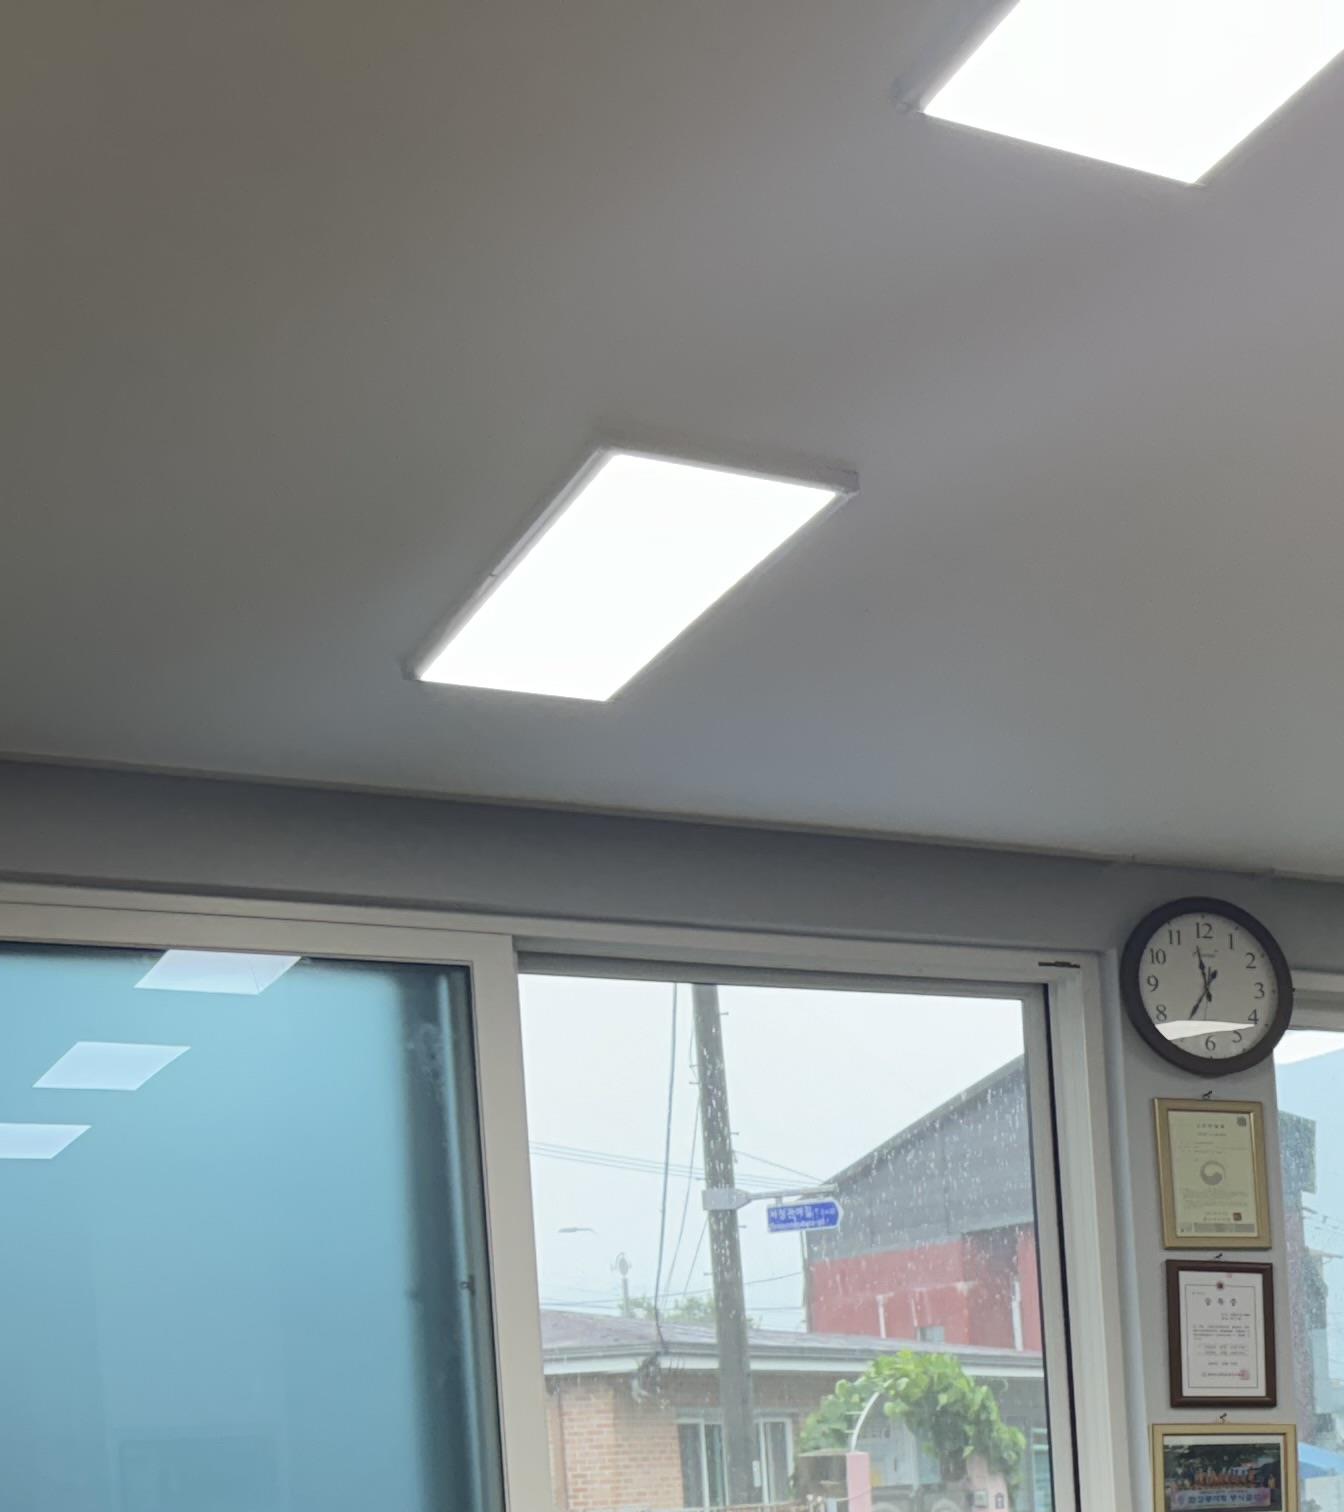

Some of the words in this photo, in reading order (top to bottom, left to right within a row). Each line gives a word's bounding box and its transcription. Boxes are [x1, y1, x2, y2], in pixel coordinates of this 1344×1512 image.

[1168, 929, 1181, 945] 11
[1196, 922, 1214, 939] 12
[1229, 933, 1234, 950] 1
[1150, 948, 1167, 965] 10
[1245, 952, 1257, 969] 2
[1147, 975, 1159, 992] 9
[1254, 982, 1265, 999] 3
[1156, 1004, 1167, 1021] 8
[1248, 1009, 1259, 1024] 4
[1205, 1036, 1216, 1051] 6
